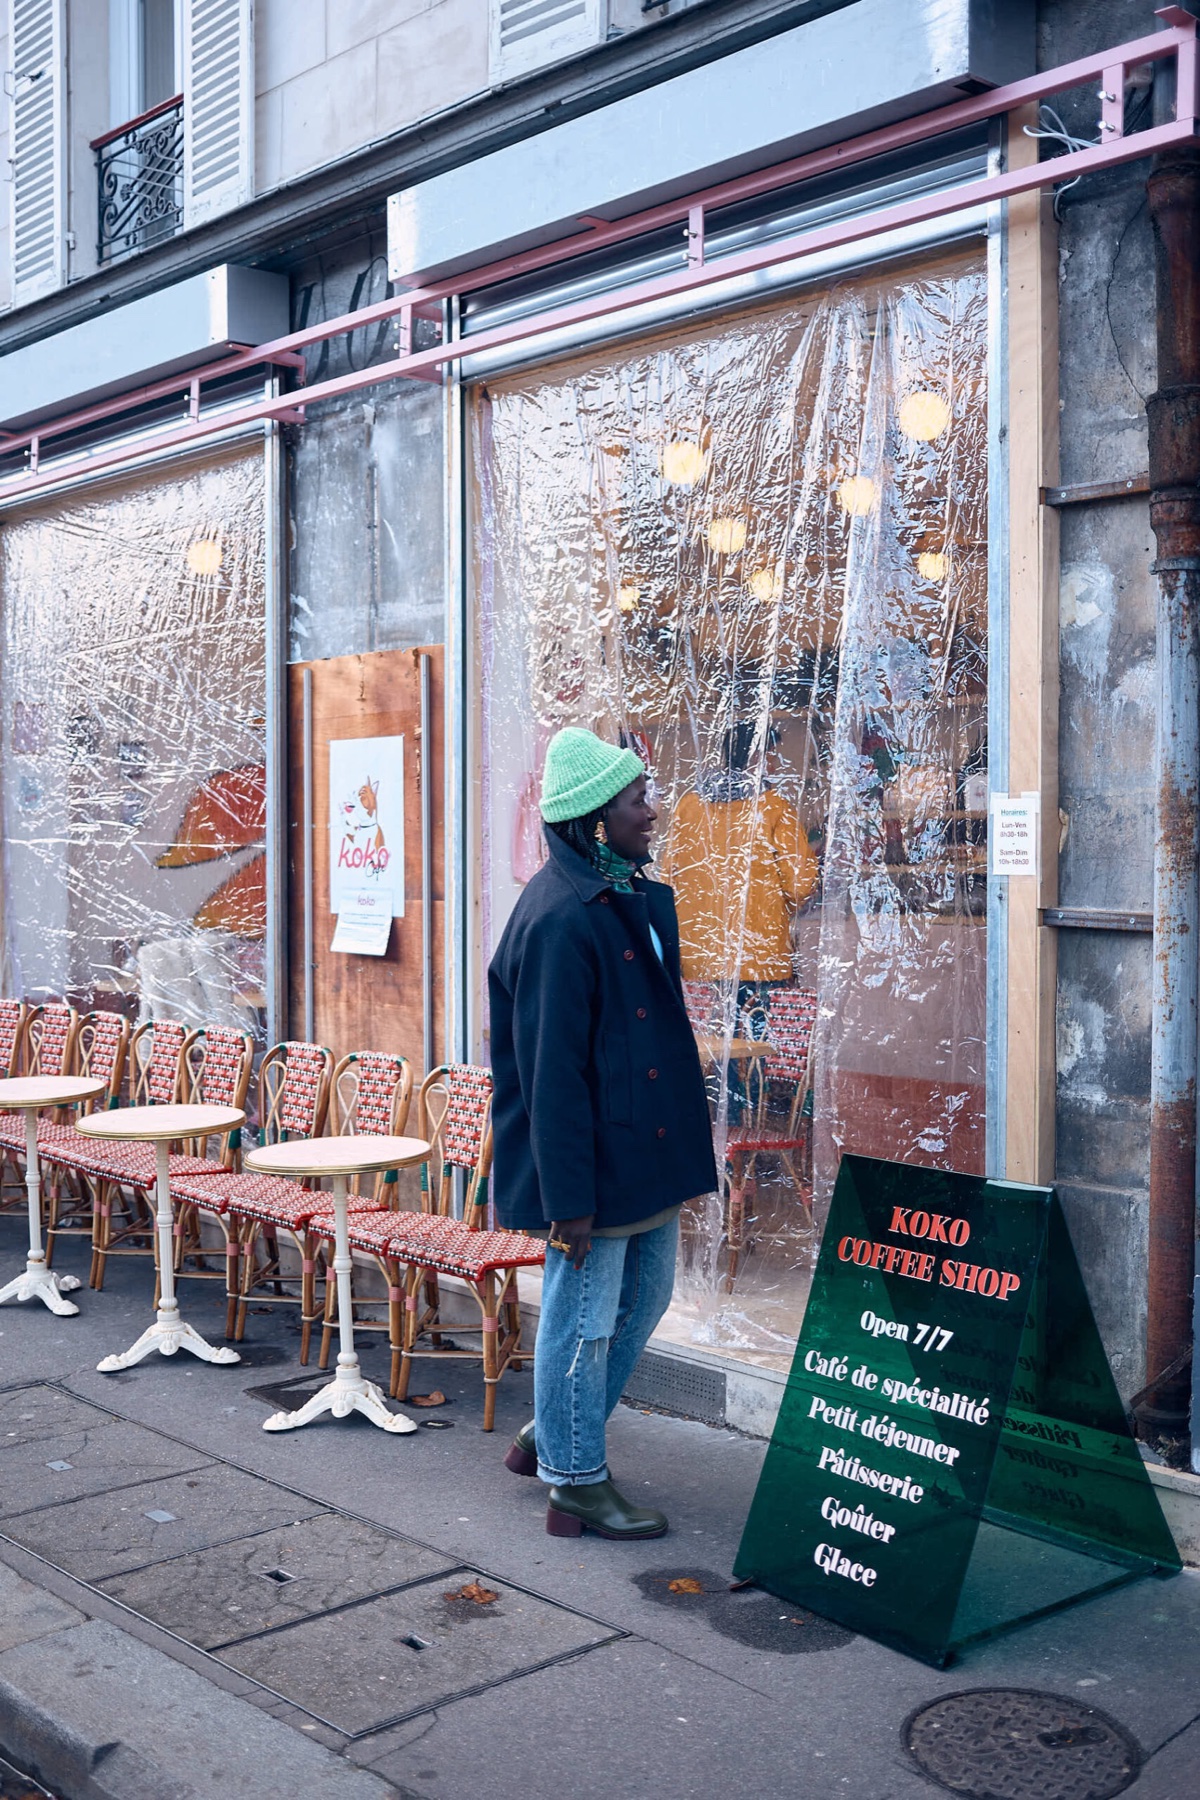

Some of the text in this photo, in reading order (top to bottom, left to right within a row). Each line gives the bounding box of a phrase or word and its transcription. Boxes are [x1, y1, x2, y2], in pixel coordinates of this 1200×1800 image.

[338, 837, 389, 868] koko
[888, 1207, 970, 1246] KOKO
[838, 1237, 1020, 1300] COFFEE SHOP
[861, 1311, 953, 1351] Open 7/7
[805, 1350, 848, 1380] Café
[852, 1365, 878, 1390] de
[881, 1379, 989, 1425] spécialité
[807, 1396, 959, 1466] Petit-déjeuner
[817, 1447, 923, 1503] Pâtisserie
[822, 1497, 895, 1543] Goûter
[814, 1544, 876, 1586] Glace
